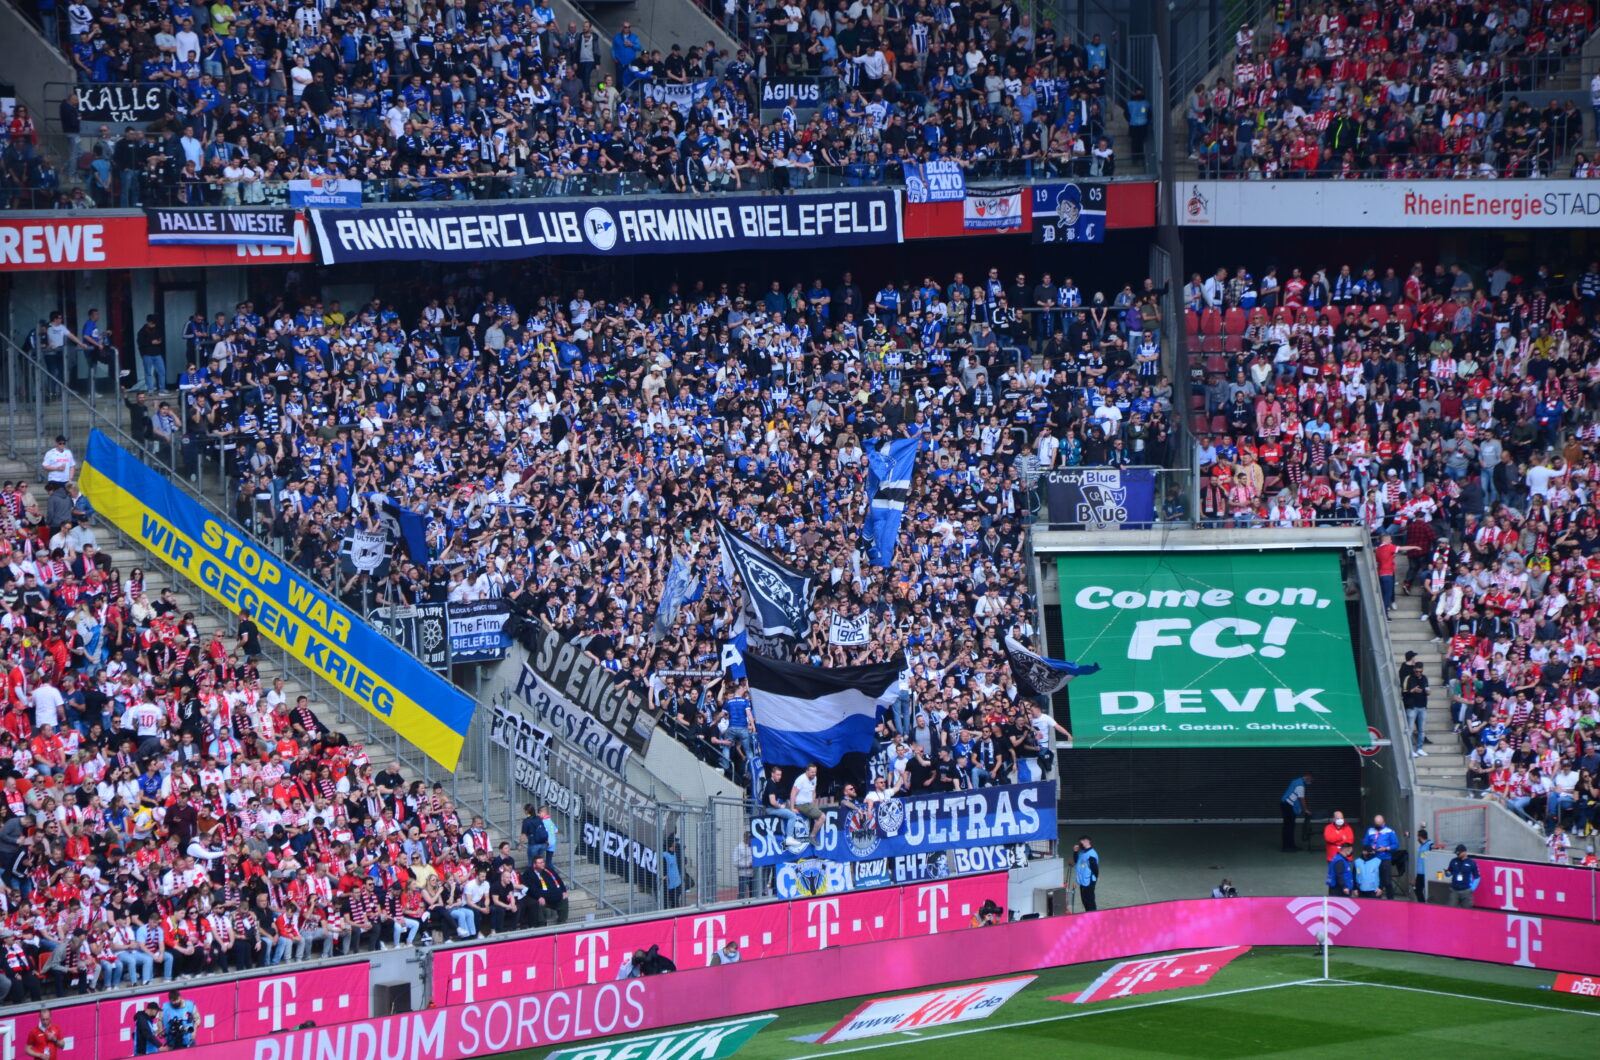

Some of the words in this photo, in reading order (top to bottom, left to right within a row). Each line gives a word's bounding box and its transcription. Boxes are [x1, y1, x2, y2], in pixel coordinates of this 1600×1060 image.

[76, 86, 161, 112] KALLE
[763, 80, 819, 102] ÁGILUS
[111, 110, 138, 122] TAL
[926, 160, 960, 174] BLOCK
[928, 173, 963, 190] ZWO
[931, 190, 964, 200] BIELEFELD
[1036, 189, 1048, 202] 19
[1089, 188, 1101, 201] 05
[158, 211, 216, 232] HALLE
[230, 212, 287, 234] WESTF.
[336, 210, 584, 250] ANHÄNGERCLUB
[619, 206, 735, 242] ARMINIA
[739, 200, 888, 238] BIELEFELD
[0, 225, 106, 264] REWE
[1086, 471, 1117, 483] Blue
[356, 535, 386, 543] ULTRAS
[201, 519, 281, 585] STOP
[288, 586, 351, 643] WAR
[1075, 586, 1234, 609] Come
[1245, 588, 1331, 609] on,
[141, 513, 193, 568] WIR
[199, 560, 299, 647] GEGEN
[304, 635, 394, 718] KRIEG
[452, 621, 473, 634] The
[476, 619, 500, 631] Firm
[453, 635, 500, 649] BIELEFELD
[838, 629, 865, 642] 1905
[1127, 617, 1297, 660] FC!
[536, 629, 642, 737] SPENGE
[1100, 687, 1332, 714] DEVK
[141, 715, 154, 728] 10
[515, 665, 629, 773] Raesfeld
[1103, 723, 1173, 733] Gesagt.
[1179, 723, 1240, 731] Getan.
[1246, 722, 1337, 732] Geholfen.
[904, 787, 1041, 846] ULTRAS
[458, 980, 647, 1054] SORGLOS
